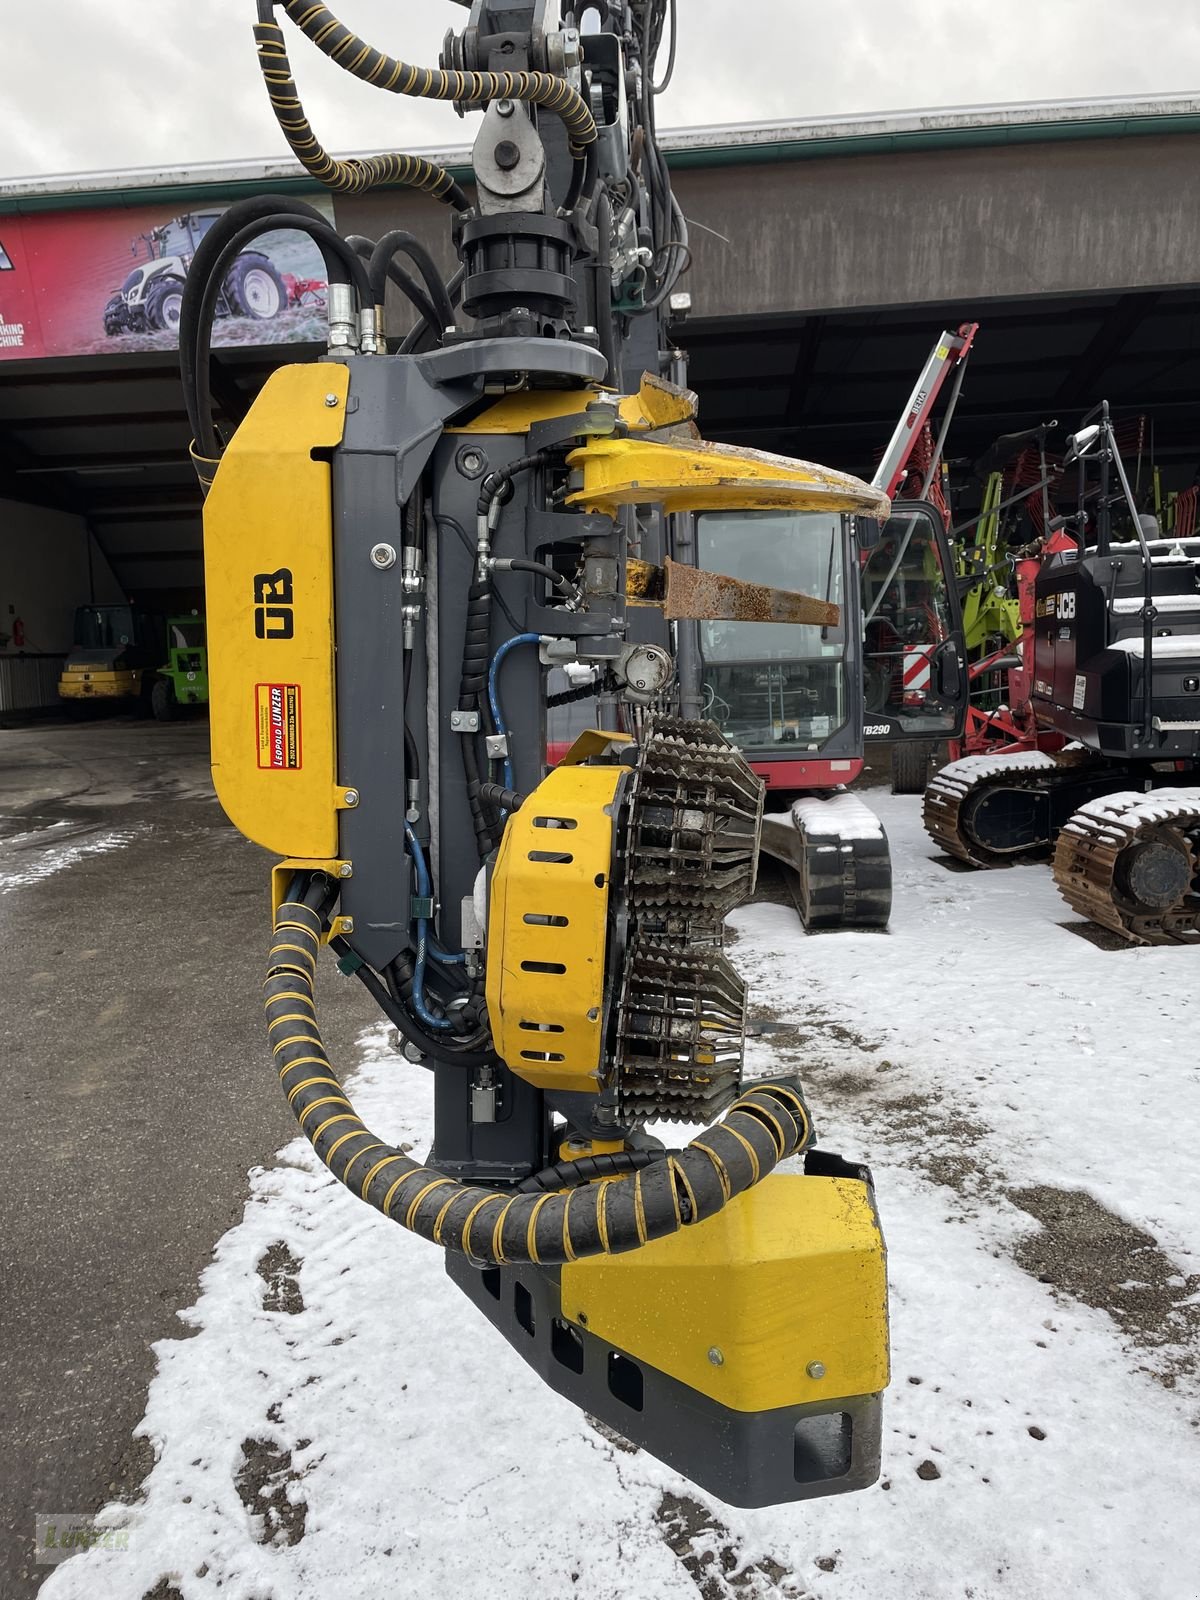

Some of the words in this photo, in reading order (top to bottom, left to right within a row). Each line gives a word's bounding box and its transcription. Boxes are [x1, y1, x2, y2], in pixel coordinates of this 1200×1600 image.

[911, 390, 927, 413] BEHA
[1057, 592, 1076, 619] JCB
[272, 688, 282, 727] LUNZER
[273, 729, 283, 766] LEOPOLD
